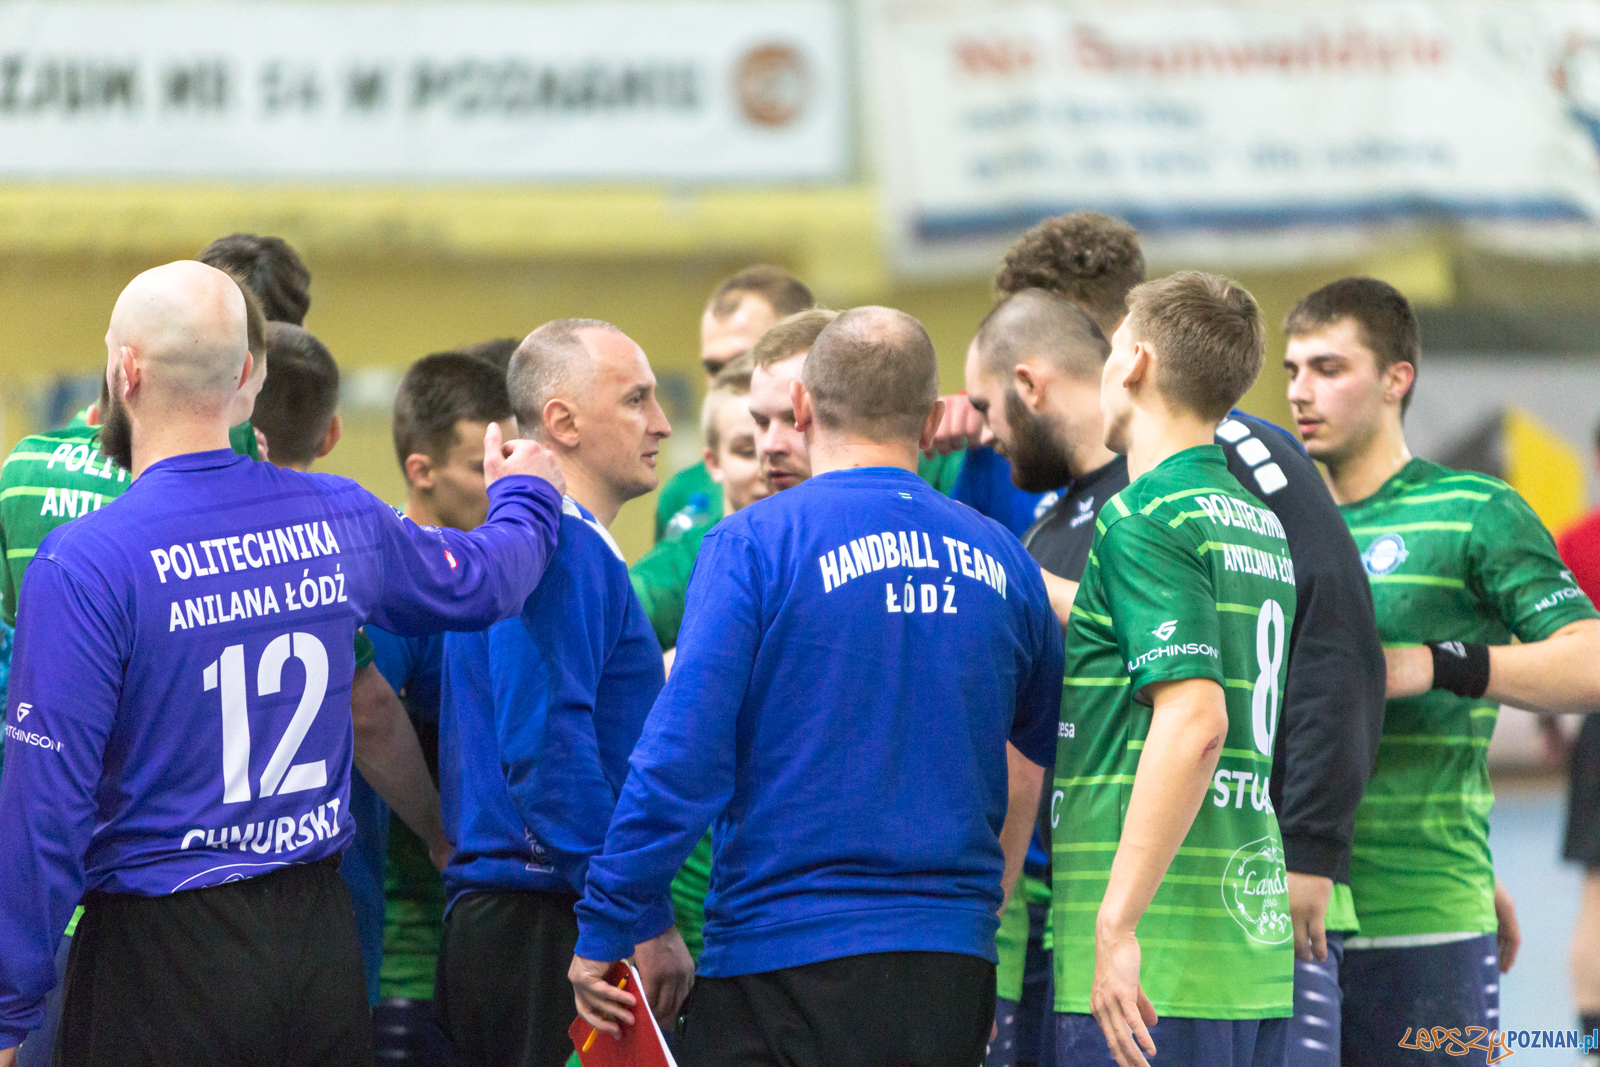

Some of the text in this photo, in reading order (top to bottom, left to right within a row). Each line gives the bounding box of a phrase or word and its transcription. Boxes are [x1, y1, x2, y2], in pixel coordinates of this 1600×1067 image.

[150, 520, 341, 584] POLITECHNIKA
[819, 530, 1007, 601] HANDBALL TEAM
[1222, 542, 1280, 581] ANILANA
[169, 563, 348, 632] ANILANA ŁÓDŹ
[886, 575, 958, 614] ŁÓDŹ
[1251, 598, 1286, 757] 8
[202, 631, 329, 805] 12
[180, 797, 341, 855] CHMURSKI
